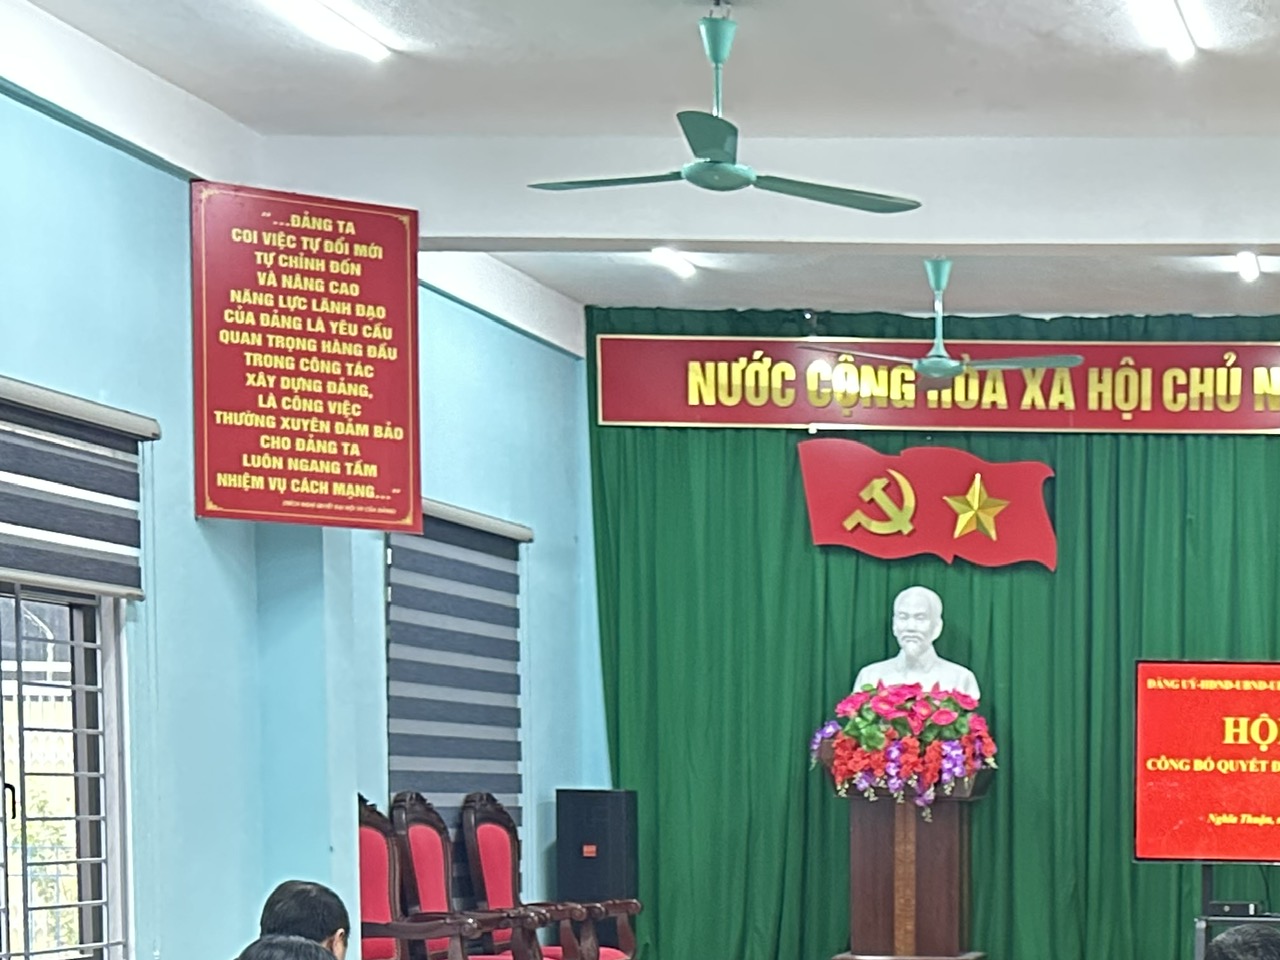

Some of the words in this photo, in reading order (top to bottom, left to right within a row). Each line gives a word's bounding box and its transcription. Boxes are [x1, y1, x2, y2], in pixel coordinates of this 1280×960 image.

[337, 220, 356, 235] TA
[231, 228, 258, 244] COI
[262, 231, 297, 250] VIỆC
[301, 236, 321, 253] TỰ
[254, 251, 276, 268] TỰ
[278, 252, 326, 272] CHỈNH
[257, 271, 277, 287] VÀ
[281, 274, 325, 293] NÂNG
[329, 281, 360, 296] CAO
[278, 295, 308, 312] LỰC
[355, 304, 386, 321] ĐẠO
[224, 305, 256, 325] CỦA
[259, 309, 302, 331] ĐẢNG
[306, 317, 326, 333] LÀ
[329, 319, 358, 337] YÊU
[219, 329, 262, 346] QUAN
[266, 334, 317, 352] TRỌNG
[321, 339, 363, 357] HÀNG
[244, 352, 295, 370] TRONG
[299, 357, 341, 375] CÔNG
[345, 361, 374, 378] TÁC
[245, 371, 276, 388] XÂY
[280, 376, 323, 393] DỰNG
[688, 350, 796, 408] NƯỚC
[806, 354, 916, 416] CỘNG
[1087, 356, 1152, 420] HỘI
[1162, 351, 1242, 412] CHỦ
[258, 392, 277, 409] LÀ
[281, 395, 324, 413] CÔNG
[328, 400, 362, 418] VIỆC
[280, 416, 330, 433] XUYÊN
[334, 417, 369, 437] ĐẢM
[373, 421, 404, 440] BẢO
[260, 434, 292, 450] CHO
[295, 434, 338, 454] ĐẢNG
[342, 443, 361, 457] TA
[242, 453, 283, 470] LUÔN
[288, 457, 341, 475] NGANG
[216, 472, 265, 491] NHIỆM
[268, 477, 287, 495] VỤ
[290, 477, 329, 495] CÁCH
[1146, 754, 1191, 771] CÔNG
[1216, 757, 1269, 774] QUYẾT
